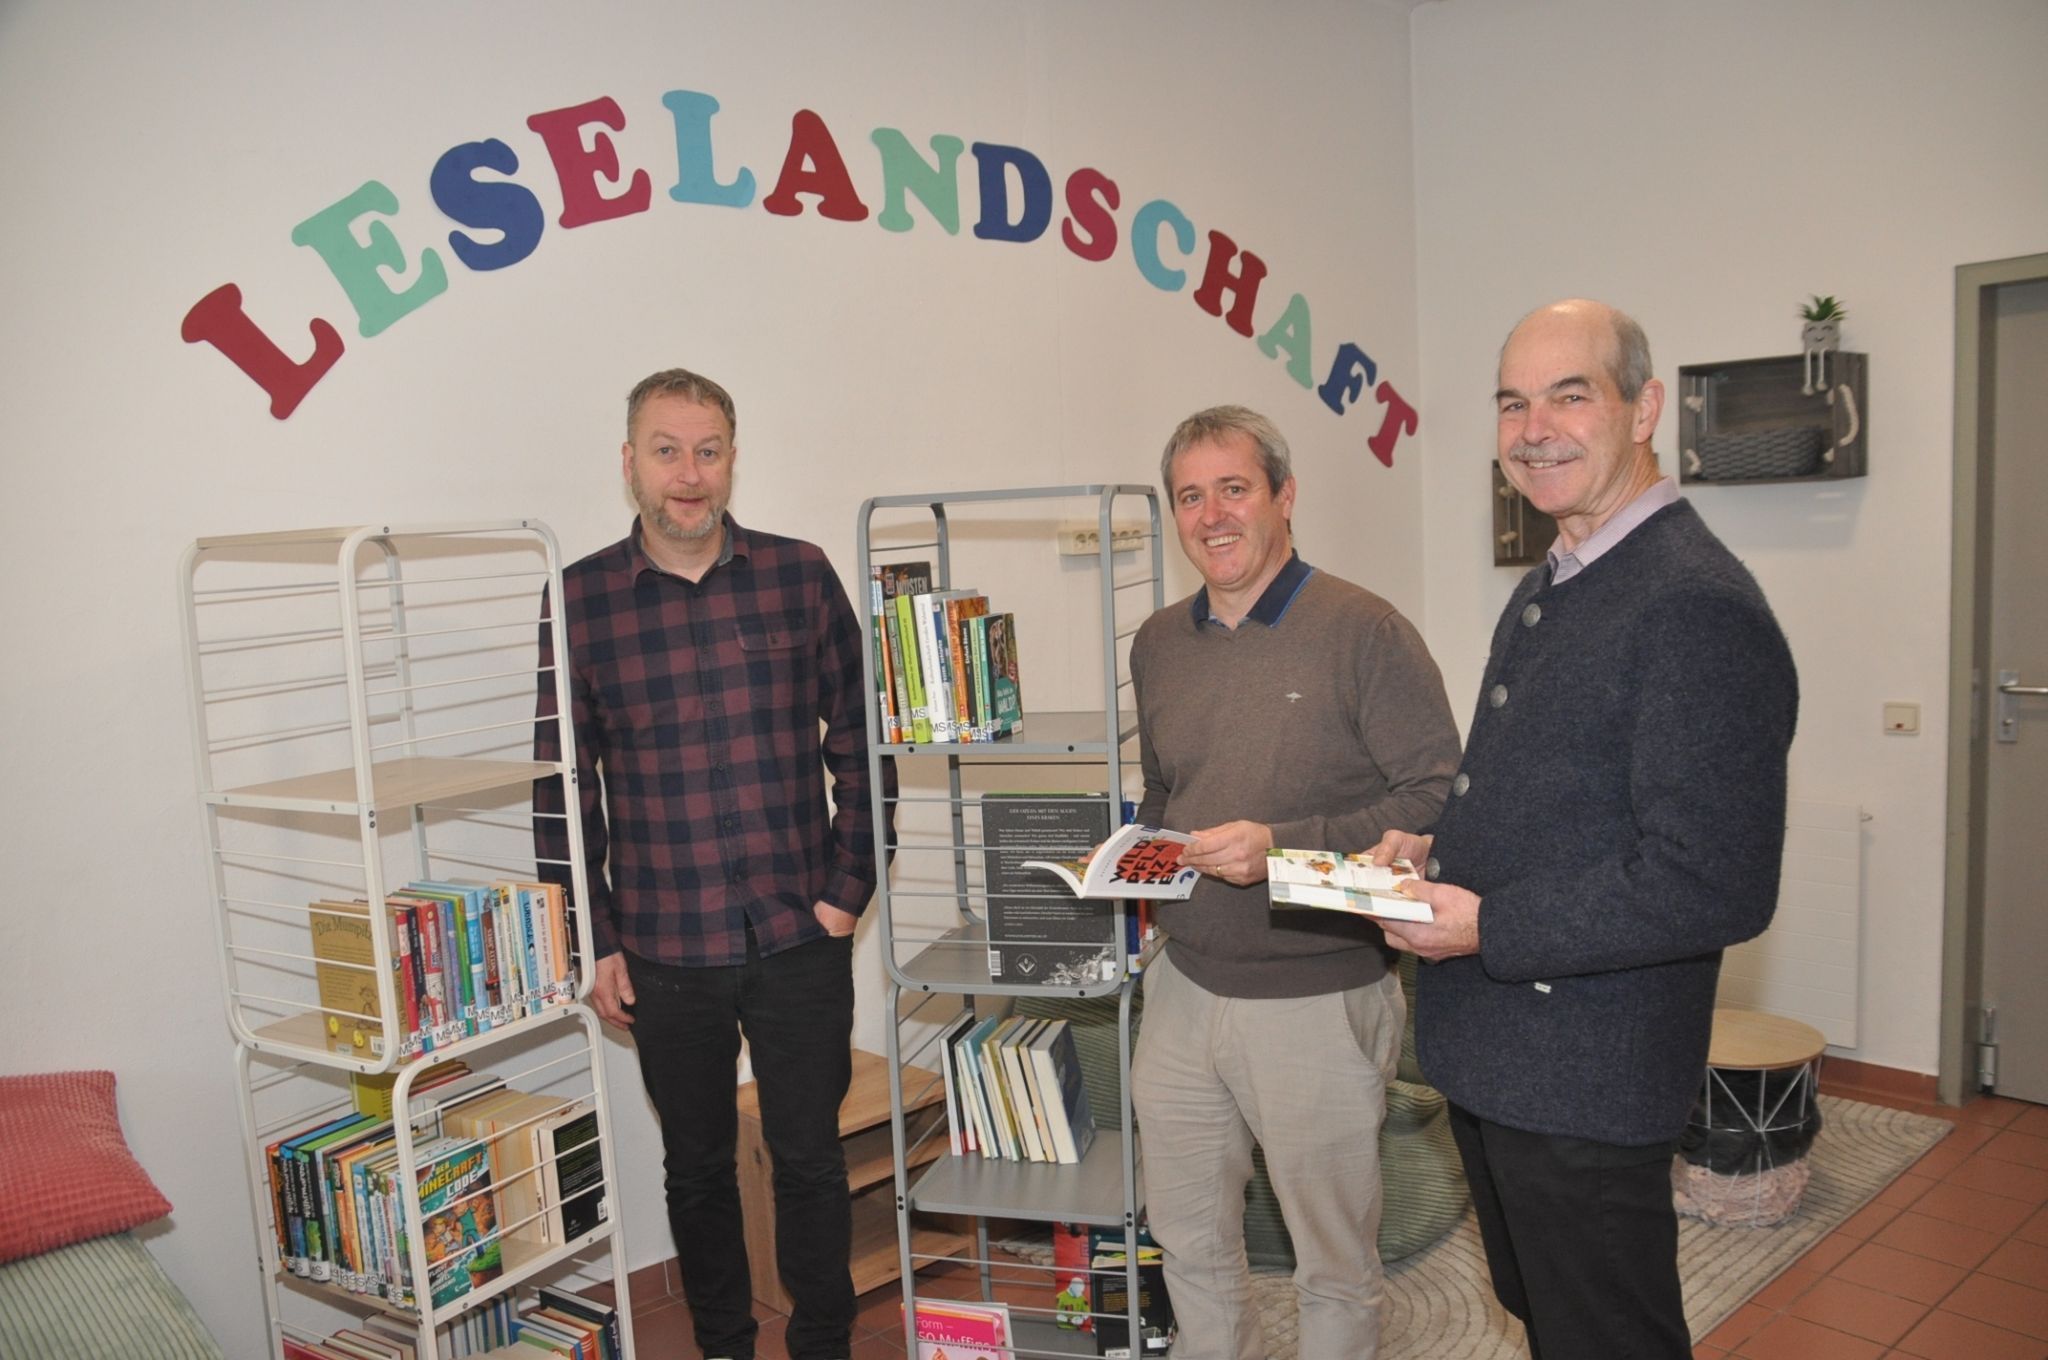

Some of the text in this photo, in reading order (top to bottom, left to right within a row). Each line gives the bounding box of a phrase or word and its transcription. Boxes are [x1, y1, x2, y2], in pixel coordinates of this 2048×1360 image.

[181, 89, 1419, 468] LESELANDSCHAFT
[912, 708, 926, 718] MS
[932, 722, 947, 732] MS
[1108, 840, 1153, 884] WILD
[1126, 843, 1171, 884] PFLA
[1142, 859, 1171, 885] NZ
[1158, 861, 1181, 885] EN
[544, 983, 556, 993] MS
[477, 1008, 490, 1019] MS
[437, 1028, 451, 1041] MS
[435, 1161, 450, 1175] DER
[446, 1169, 479, 1198] CODE
